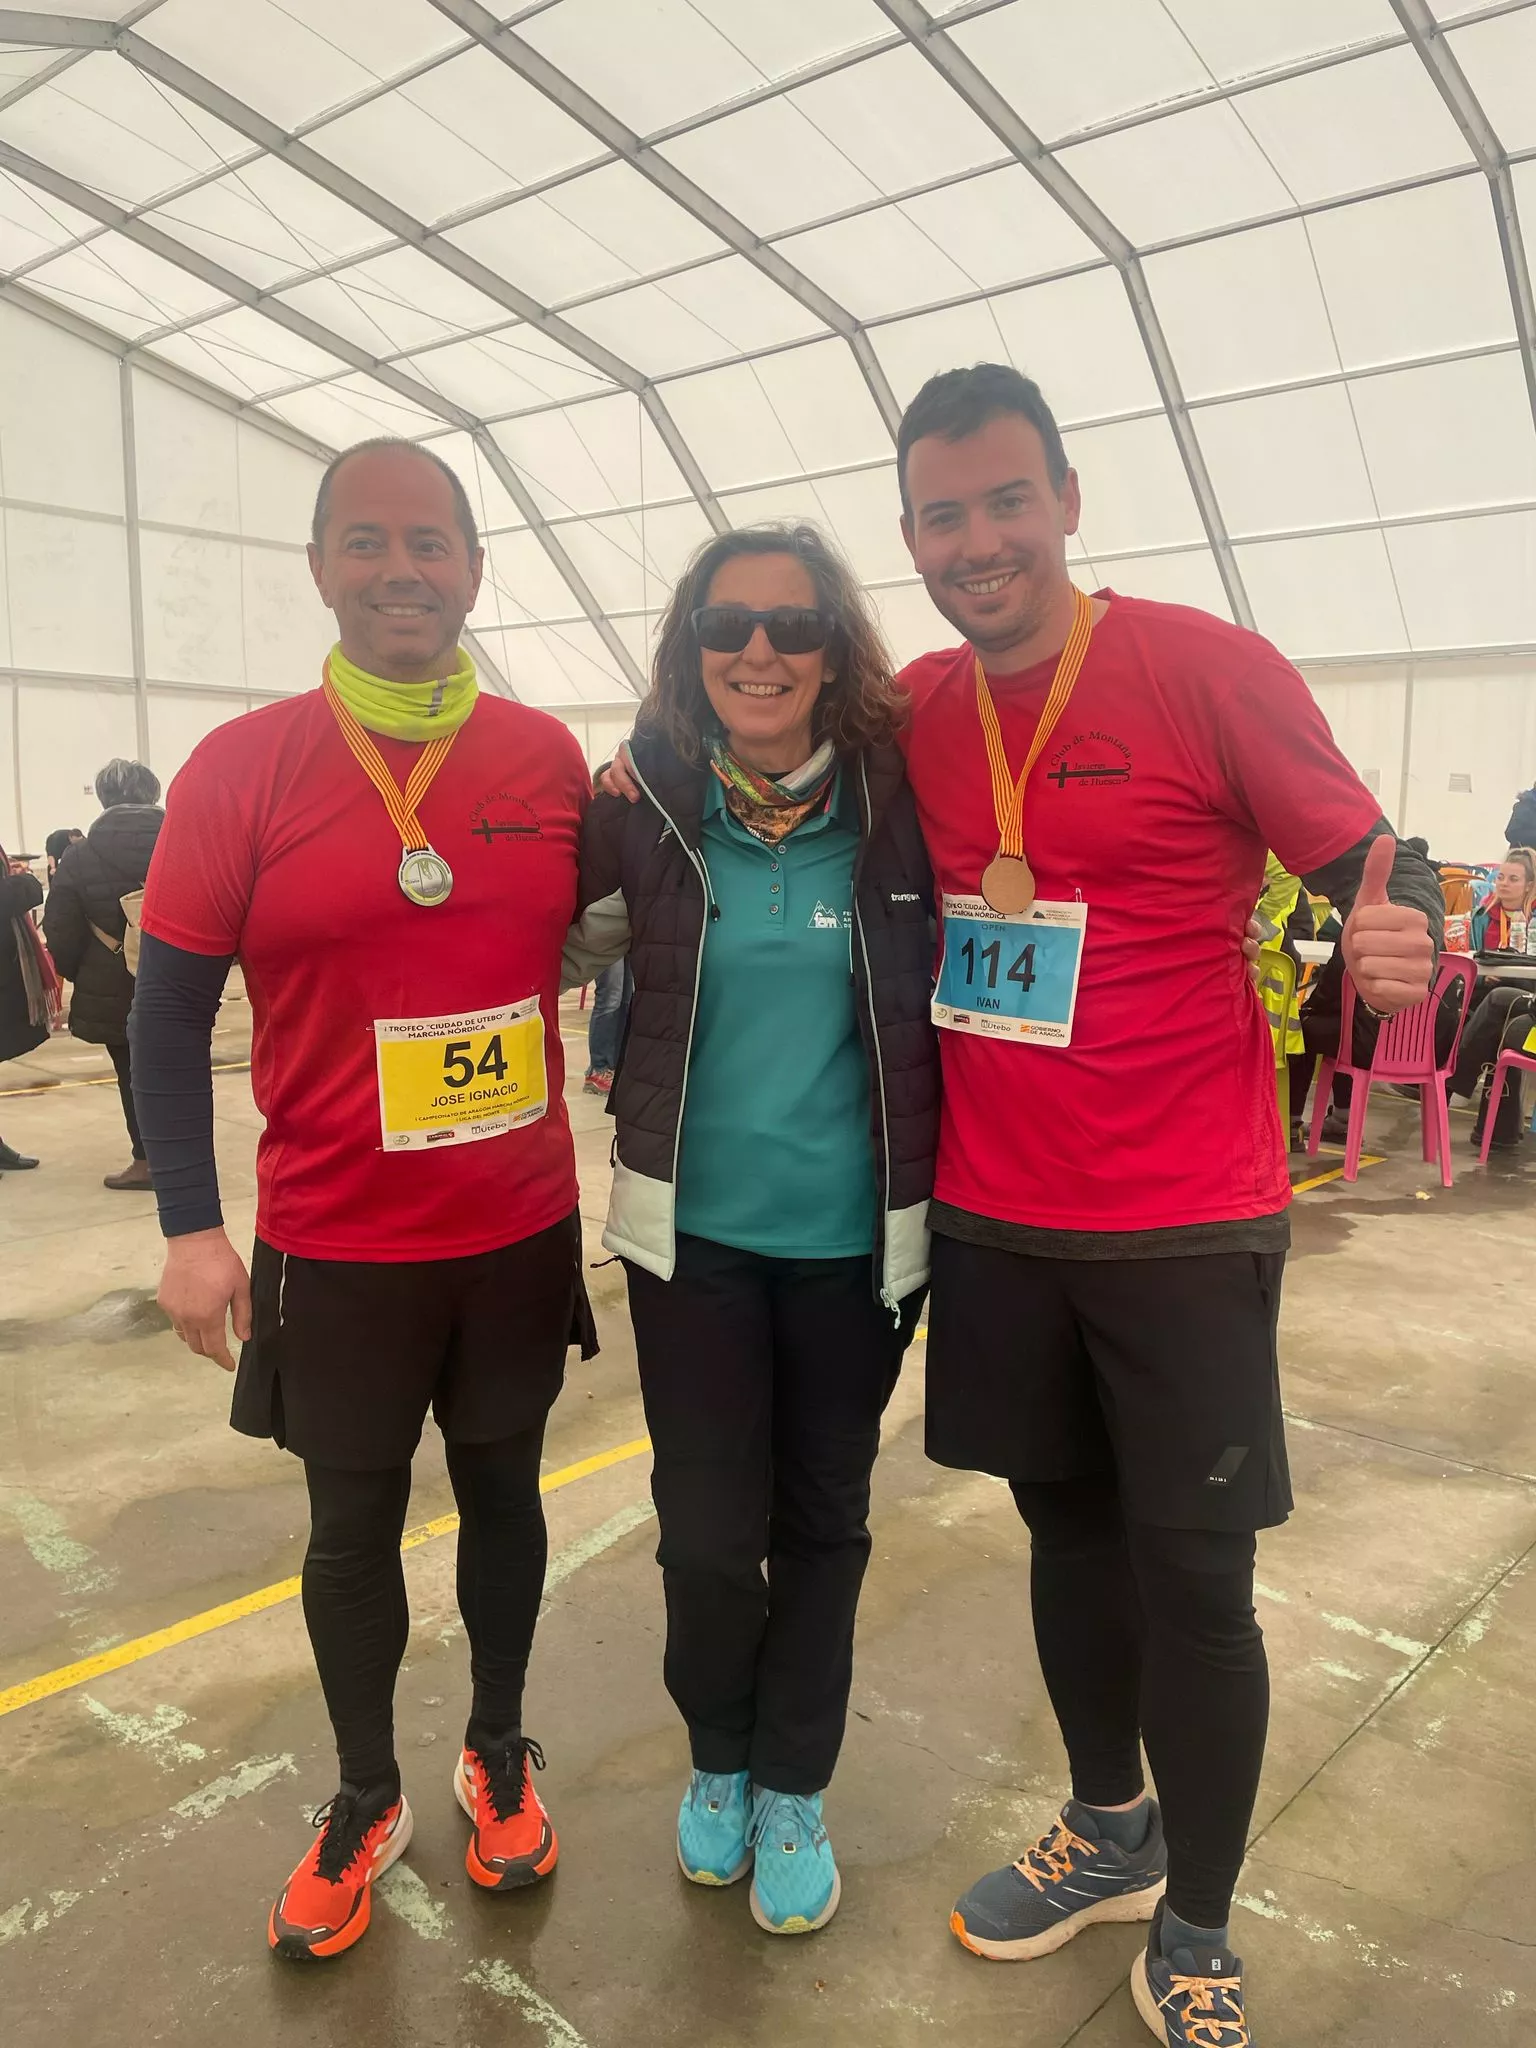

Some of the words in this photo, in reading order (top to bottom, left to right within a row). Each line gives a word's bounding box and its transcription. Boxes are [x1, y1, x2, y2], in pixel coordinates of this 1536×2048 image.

[1051, 744, 1071, 766] Club
[1073, 735, 1085, 745] de
[1089, 731, 1131, 759] Montaña
[1078, 778, 1088, 786] de
[1090, 778, 1121, 786] Huesca
[468, 801, 485, 823] Club
[486, 794, 497, 803] de
[981, 923, 1006, 932] OPEN
[961, 937, 1036, 992] 114
[976, 997, 1000, 1010] IVAN
[388, 1024, 424, 1033] TROFEO
[464, 1018, 475, 1026] DE
[408, 1030, 446, 1039] MARCHA
[447, 1024, 486, 1035] NÓRDICA
[443, 1034, 508, 1088] 54
[431, 1091, 465, 1108] JOSE
[469, 1082, 518, 1102] IGNACIO
[418, 1112, 458, 1122] CAMPEONATO
